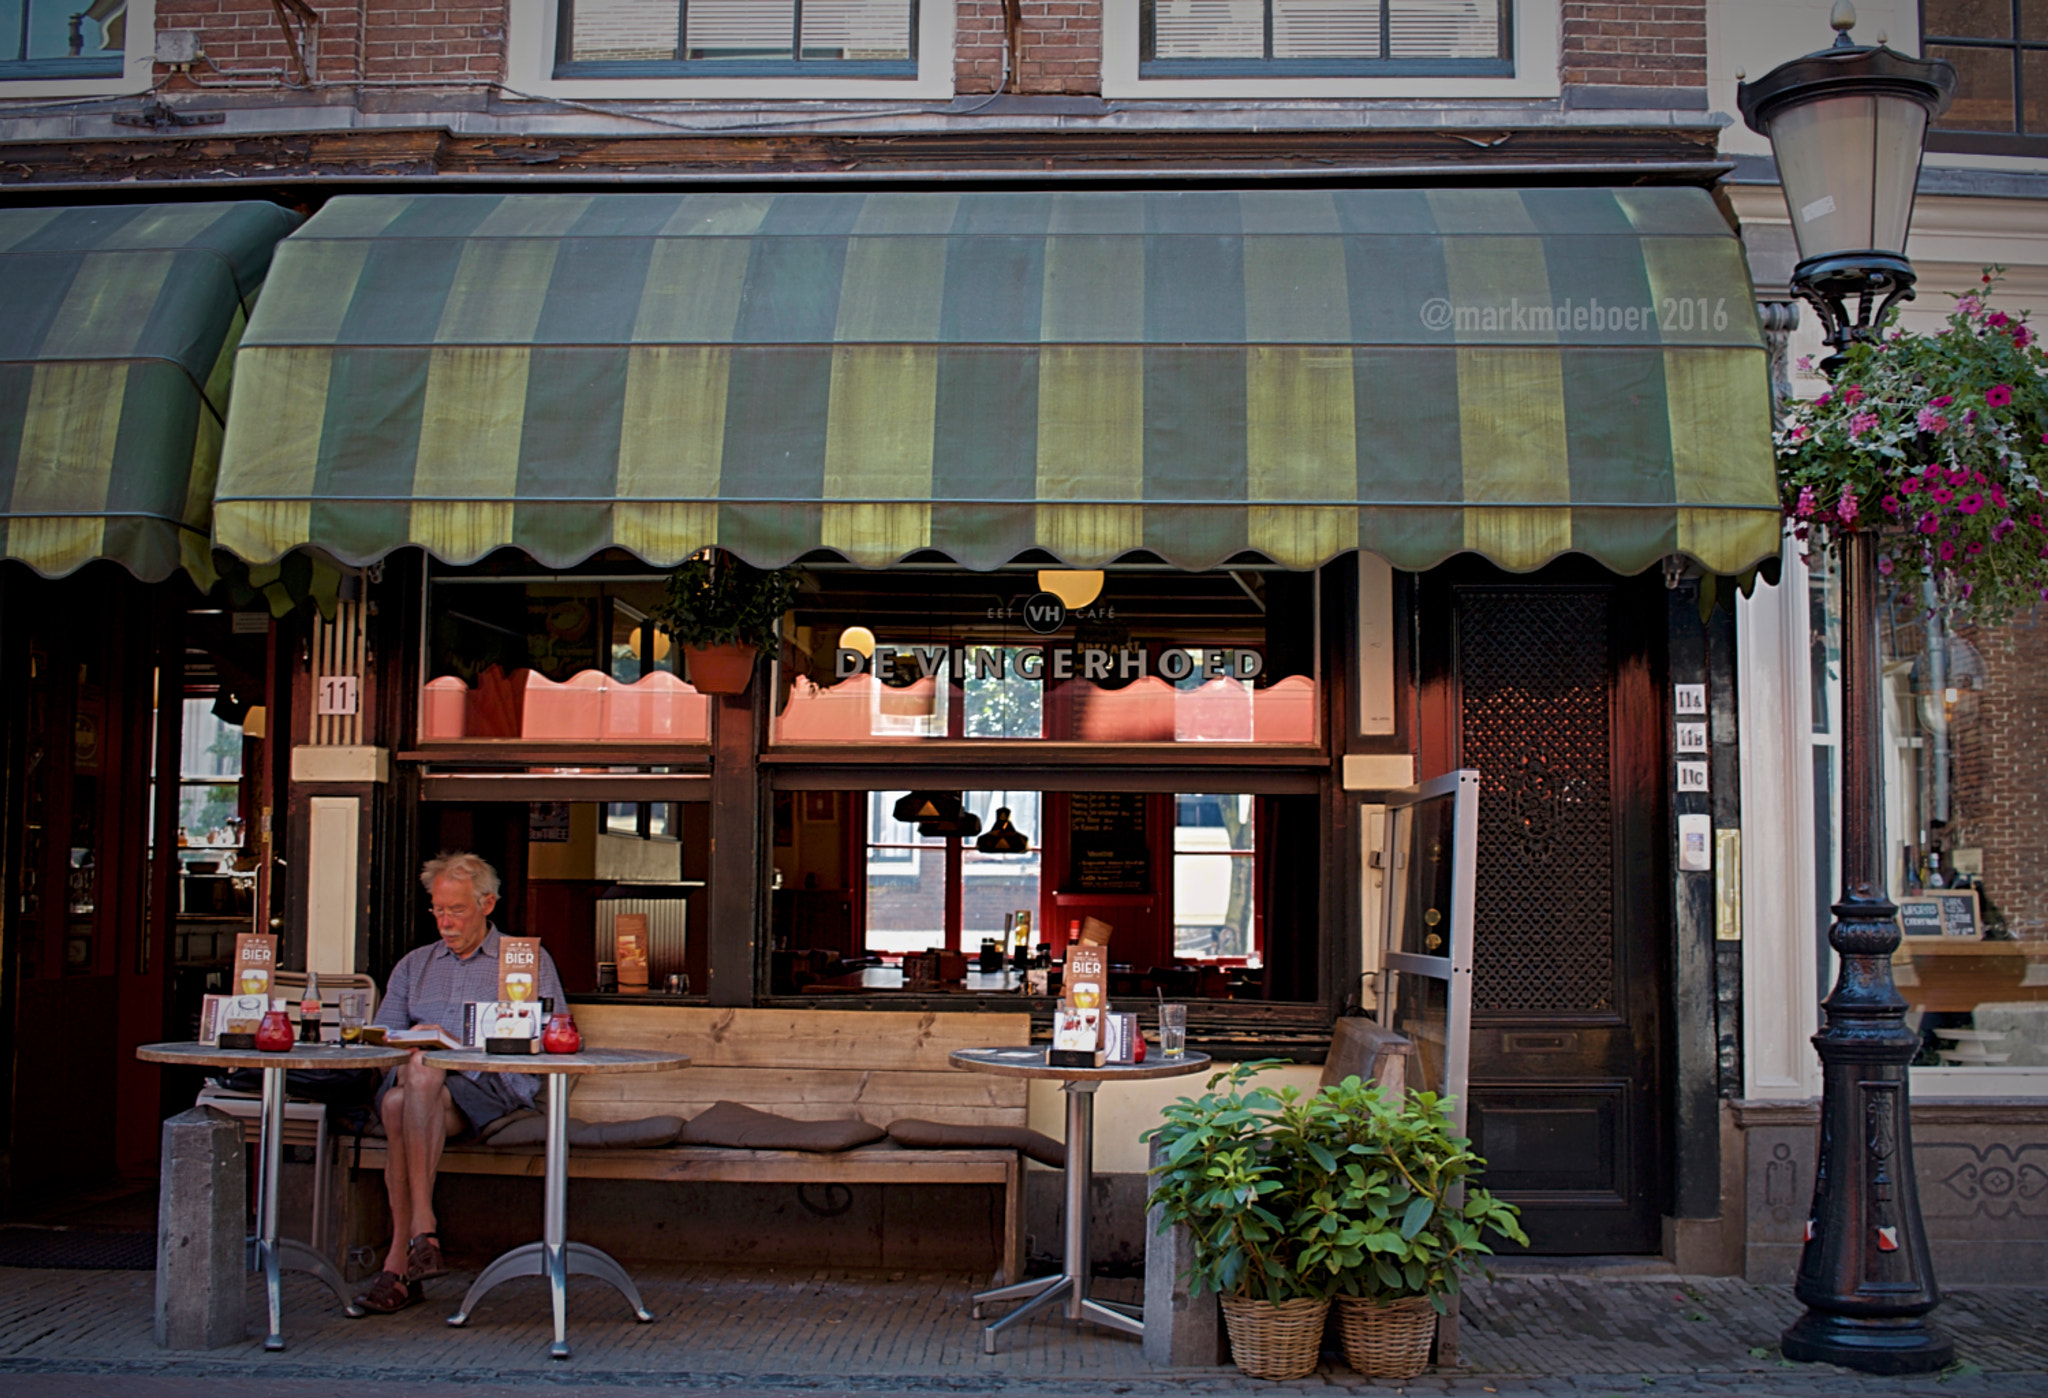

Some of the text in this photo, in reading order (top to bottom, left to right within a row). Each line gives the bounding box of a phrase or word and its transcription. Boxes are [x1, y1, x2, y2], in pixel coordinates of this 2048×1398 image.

[986, 604, 1116, 622] EET VH CAFÉ
[835, 648, 896, 680] DE
[913, 648, 1264, 680] VINGERHOED
[326, 681, 347, 710] 11
[242, 948, 272, 961] BIER
[505, 952, 535, 964] BIER
[1072, 961, 1102, 974] BIER
